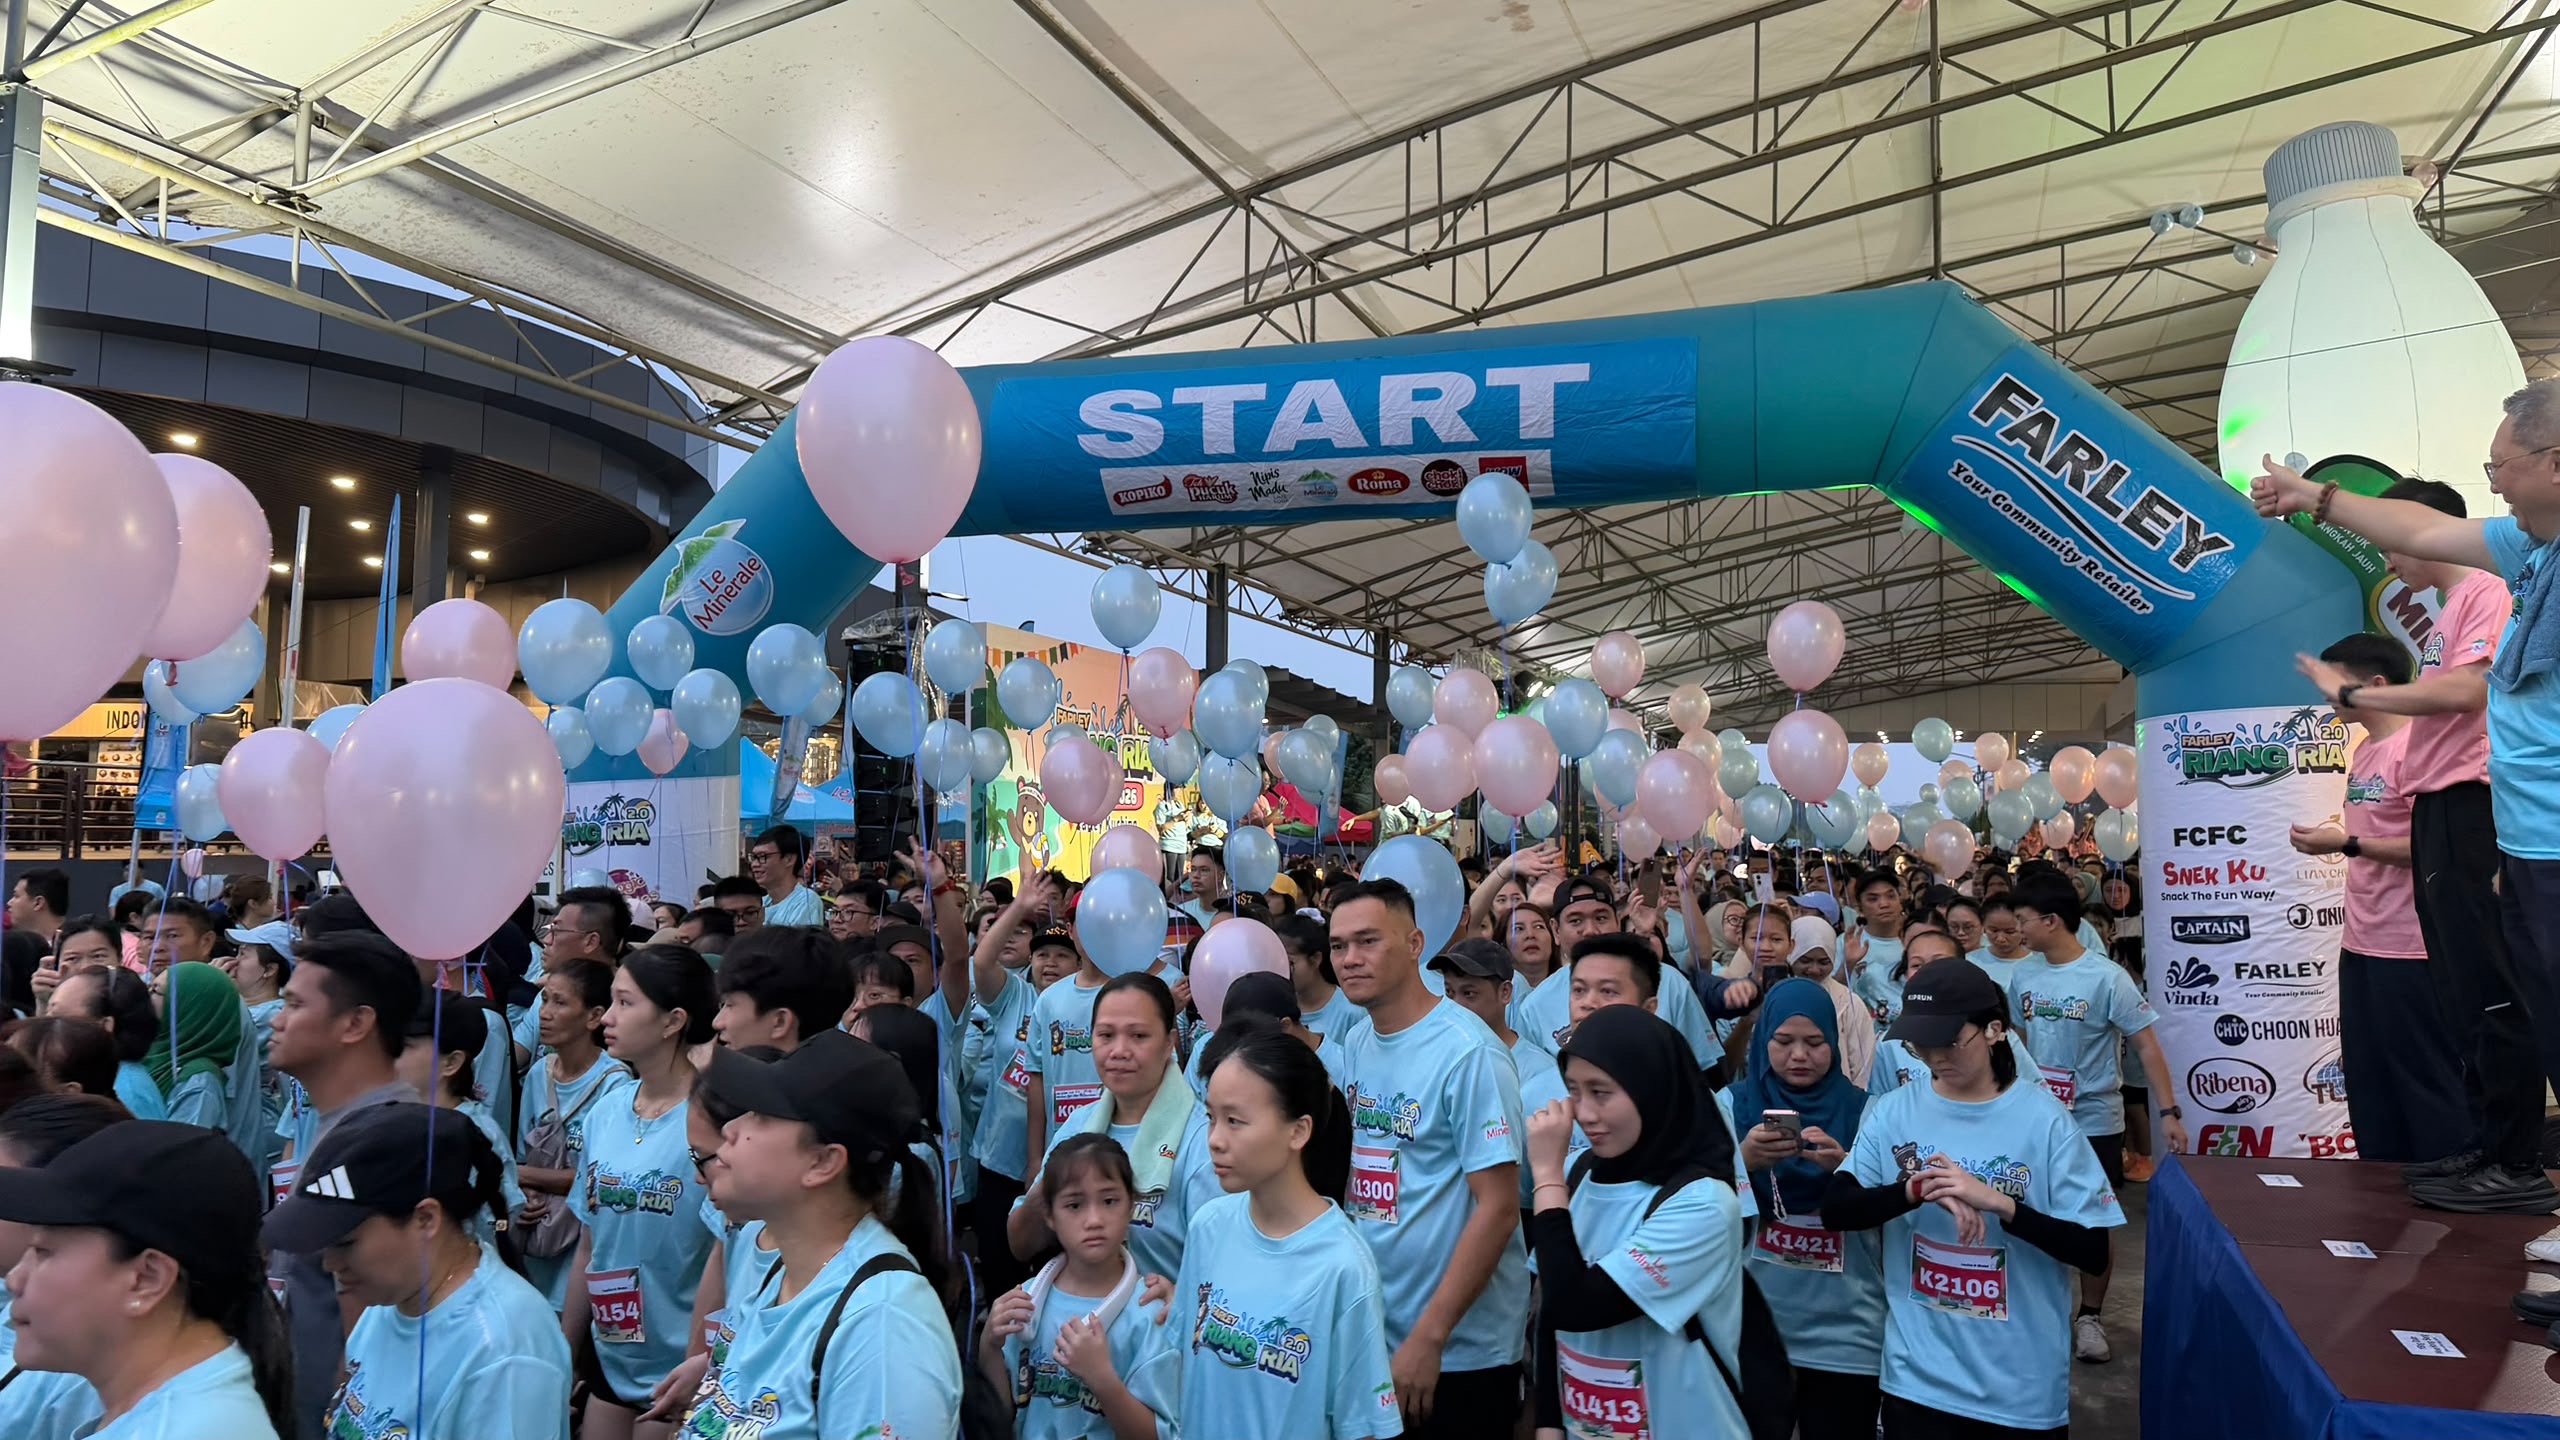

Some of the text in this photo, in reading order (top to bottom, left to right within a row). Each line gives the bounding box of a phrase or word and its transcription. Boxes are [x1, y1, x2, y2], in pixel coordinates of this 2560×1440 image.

[1077, 363, 1591, 459] START
[1969, 372, 2235, 573] FARLEY
[1119, 484, 1167, 503] KOPIKO
[1189, 481, 1235, 500] Pucuk
[1248, 481, 1289, 502] Madu
[1356, 477, 1402, 491] Roma
[1949, 459, 2154, 615] Your Community Retailer
[2317, 520, 2376, 574] ANGKAH JAUH
[699, 569, 727, 595] Le
[693, 557, 762, 630] Minerale
[2181, 732, 2235, 748] FARLEY
[2320, 725, 2344, 740] 2.0
[2182, 743, 2346, 777] RIANG RIA
[626, 807, 650, 820] 2.0
[565, 822, 651, 847] ANG RIA
[2173, 825, 2248, 847] FCFC
[2160, 889, 2276, 902] Snack The Fun Way!
[2172, 919, 2246, 937] CAPTAIN
[2234, 960, 2327, 980] FARLEY
[2164, 990, 2220, 1007] Vinda
[2251, 1019, 2311, 1041] CHOON
[2195, 1071, 2268, 1098] Ribena
[1392, 1115, 1415, 1142] RIA
[2009, 1169, 2027, 1181] 2.0
[659, 1182, 679, 1194] 2.0
[1990, 1175, 2026, 1202] RIA
[638, 1190, 675, 1216] RIA
[1765, 1227, 1837, 1254] K1421
[1920, 1266, 2000, 1299] K2106
[1202, 1318, 1300, 1384] RIANG RIA
[1284, 1336, 1306, 1354] 2.0
[750, 1400, 775, 1421] 2.0
[1564, 1382, 1642, 1424] K1413
